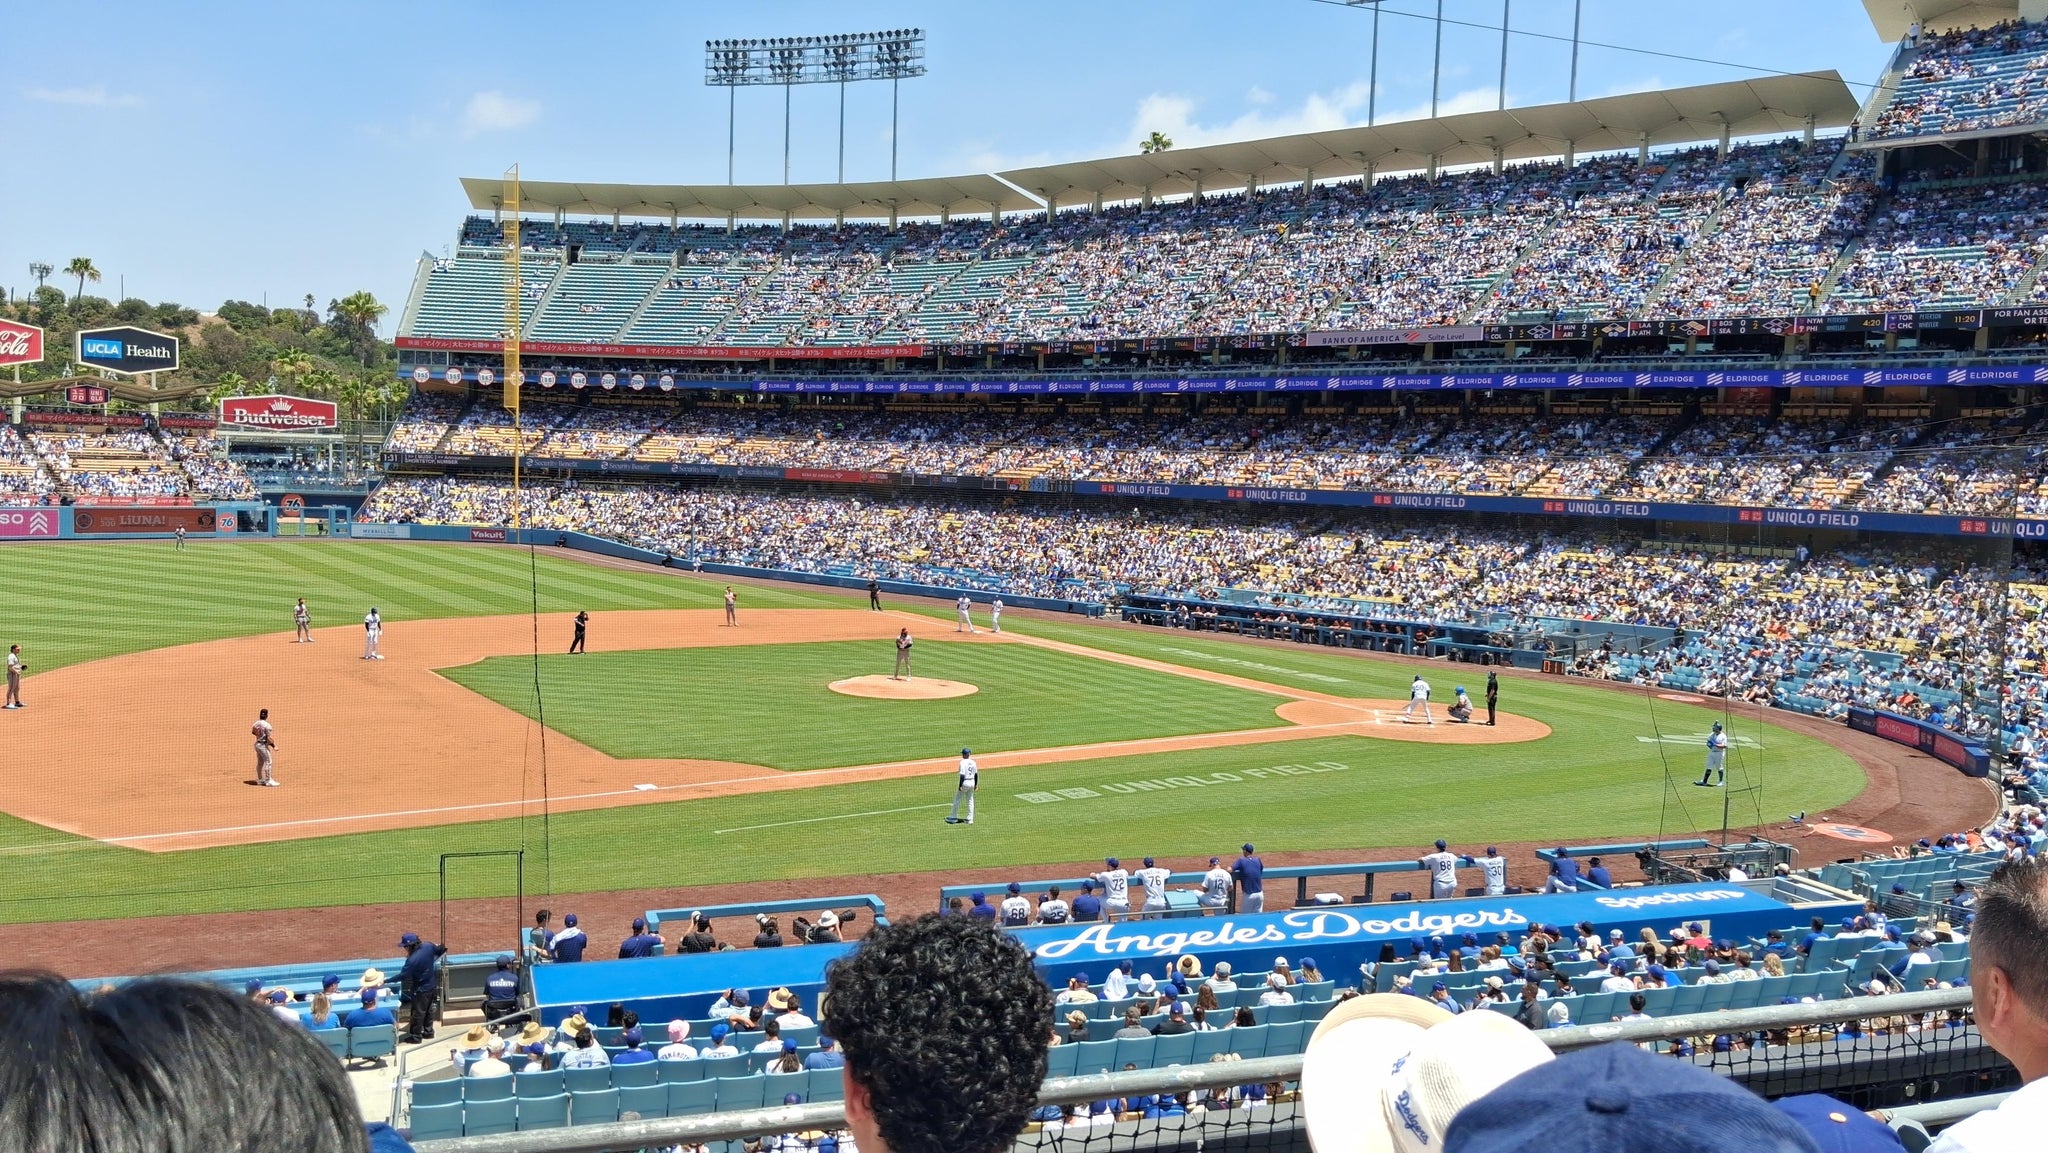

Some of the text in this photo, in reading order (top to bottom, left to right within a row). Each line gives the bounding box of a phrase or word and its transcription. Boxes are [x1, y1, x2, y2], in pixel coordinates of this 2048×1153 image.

[1954, 316, 1975, 324] 11:20
[1994, 311, 2010, 319] FOR
[1862, 319, 1881, 327] 4:20
[2024, 317, 2036, 326] OR
[1360, 335, 1400, 343] AMERICA
[87, 343, 171, 360] UCLA Health
[1117, 486, 1145, 496] UNIQLO
[1147, 487, 1170, 496] FIELD
[1246, 491, 1278, 501] UNIQLO
[1280, 492, 1307, 502] FIELD
[285, 499, 301, 510] 76
[1394, 496, 1431, 508] UNIQLO
[1434, 497, 1465, 508] FIELD
[1568, 502, 1610, 515] UNIQLO
[1614, 504, 1649, 516] FIELD
[0, 514, 24, 524] SO
[120, 515, 166, 525] LiUNA!
[221, 517, 234, 528] 76
[1767, 511, 1815, 525] UNIQLO
[1819, 513, 1859, 526] FIELD
[472, 530, 505, 539] Yakult
[1100, 761, 1350, 794] UNIQLO FIELD
[1440, 861, 1451, 871] 88
[1492, 866, 1502, 876] 30
[1113, 878, 1125, 890] 72
[1148, 876, 1161, 887] 76
[1214, 878, 1224, 890] 12
[1595, 888, 1746, 909] Spectrum
[1011, 908, 1025, 919] 68
[1036, 908, 1528, 958] Angeles Dodgers
[490, 980, 515, 988] SECURITY
[1394, 1090, 1429, 1145] Dodgers
